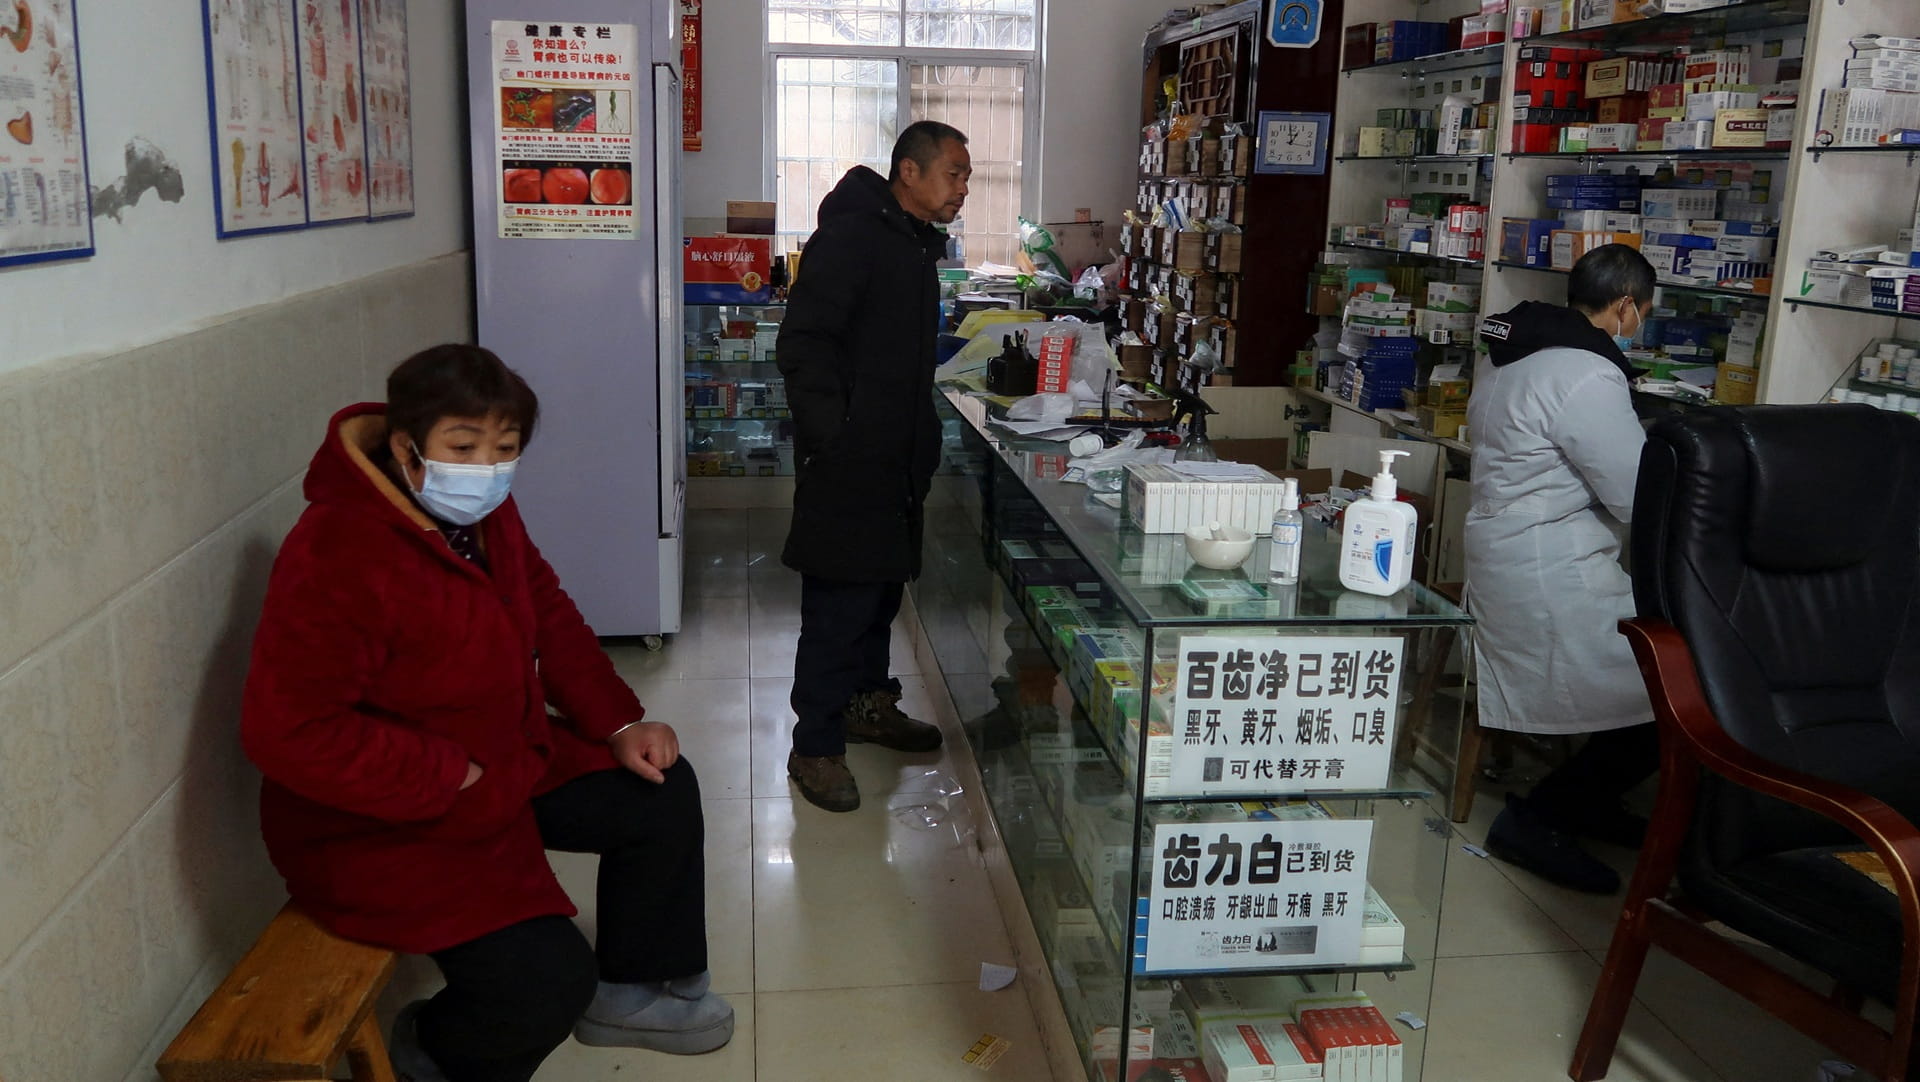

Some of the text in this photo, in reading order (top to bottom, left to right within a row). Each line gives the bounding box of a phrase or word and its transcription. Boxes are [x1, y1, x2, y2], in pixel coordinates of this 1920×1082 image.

[525, 24, 612, 39] 健康专栏
[516, 70, 631, 82] 幽门螺杆菌是导致胃病的元凶
[690, 250, 756, 263] 脑心舒口服液
[1187, 648, 1395, 701] 百齿净已到货
[1184, 706, 1386, 746] 黑牙、黄牙、烟垢、口臭
[1230, 757, 1346, 780] 可代替牙膏
[1162, 832, 1356, 889] 齿力白 已到货
[1162, 891, 1349, 921] 口腔溃疡 牙龈出血 牙痛 黑牙
[1222, 934, 1252, 945] 齿力白
